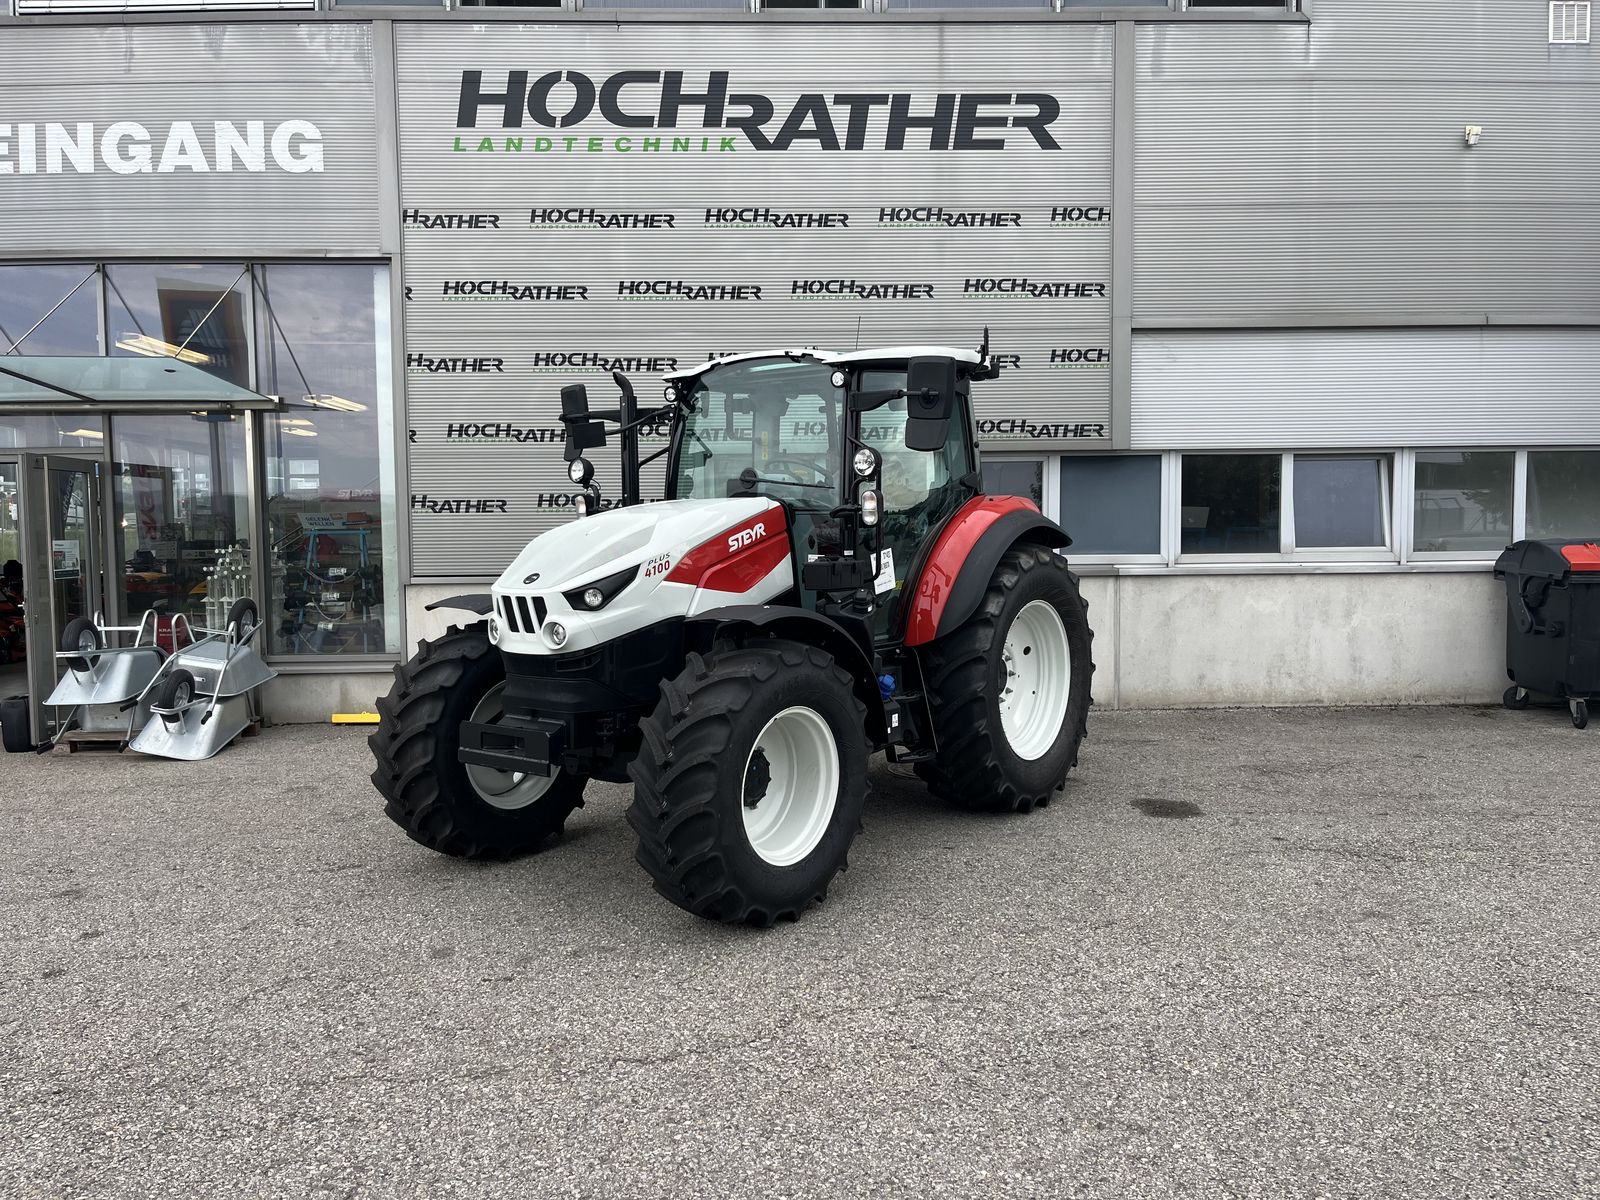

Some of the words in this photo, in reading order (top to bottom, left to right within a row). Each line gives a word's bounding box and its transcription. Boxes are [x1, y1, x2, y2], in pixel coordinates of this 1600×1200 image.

[456, 70, 1062, 151] HOCHRATHER
[453, 136, 738, 153] LANDTECHNIK
[530, 208, 675, 229] HOCHRATHER
[704, 208, 849, 228] HOCHRATHER
[879, 207, 1022, 227] HOCHRATHER
[443, 280, 589, 301] HOCHRATHER
[618, 280, 763, 300] HOCHRATHER
[791, 279, 934, 299] HOCHRATHER
[963, 278, 1106, 298] HOCHRATHER
[533, 352, 679, 372] HOCHRATHER
[727, 522, 767, 553] STEYR
[644, 560, 671, 578] 4100
[647, 552, 671, 567] PLUS
